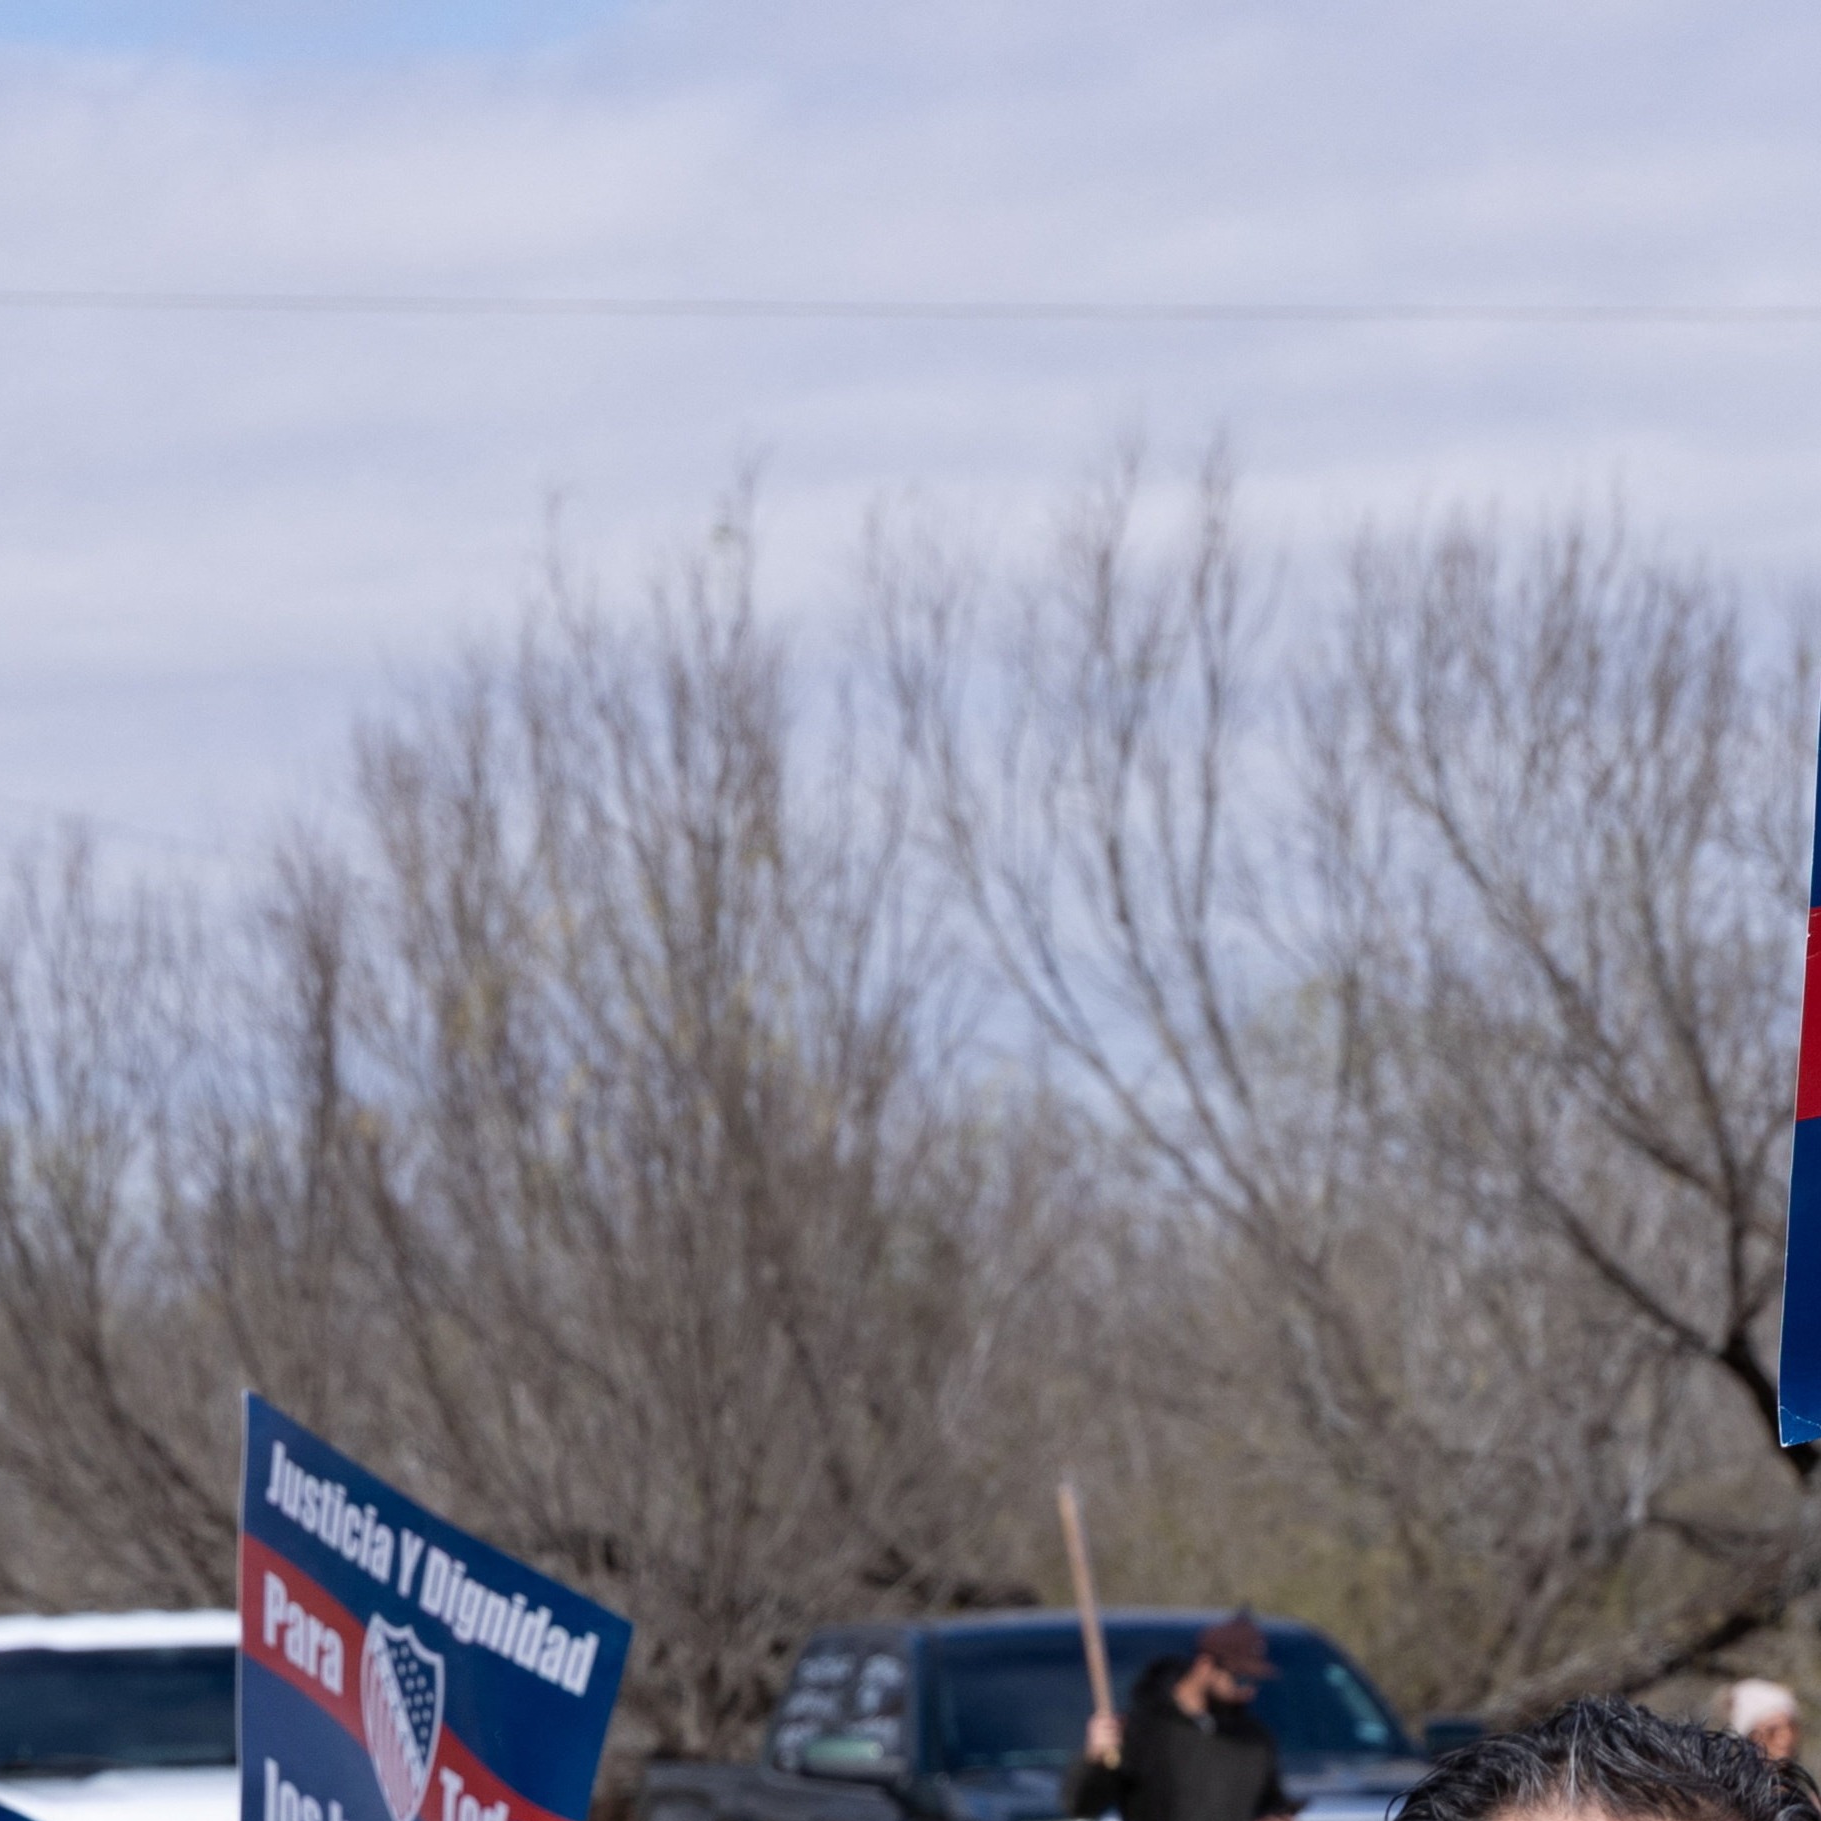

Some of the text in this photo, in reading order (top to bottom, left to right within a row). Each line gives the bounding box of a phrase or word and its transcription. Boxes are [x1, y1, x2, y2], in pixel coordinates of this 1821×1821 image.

[264, 1569, 345, 1697] Para
[266, 1440, 599, 1697] Justicia Y Dignidad
